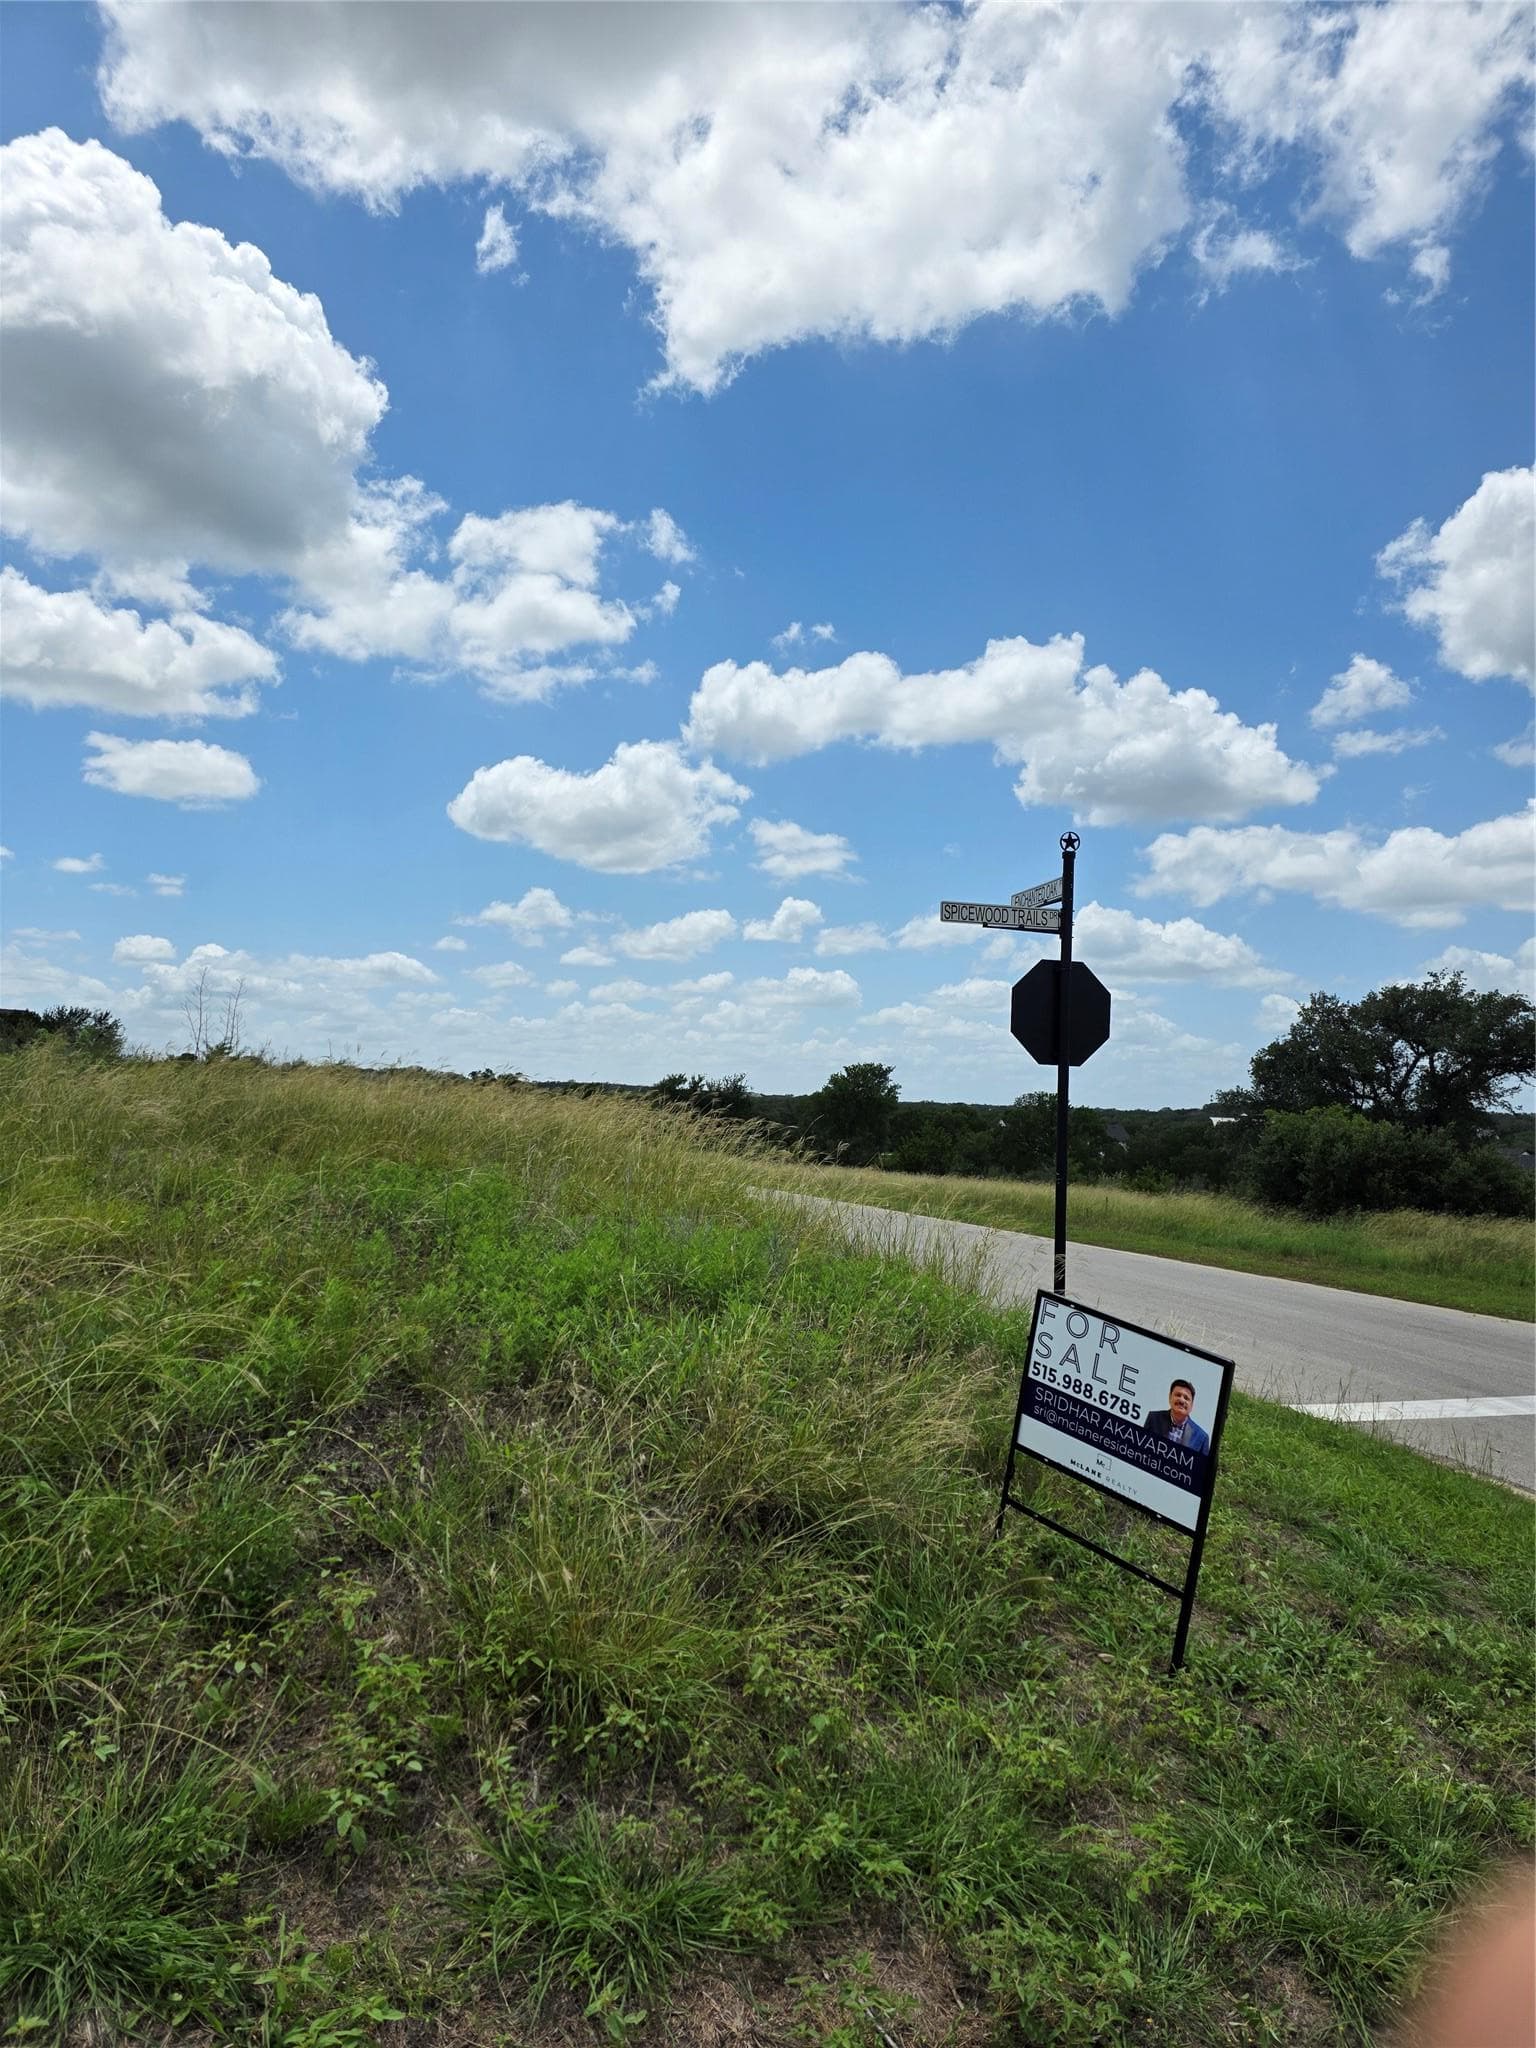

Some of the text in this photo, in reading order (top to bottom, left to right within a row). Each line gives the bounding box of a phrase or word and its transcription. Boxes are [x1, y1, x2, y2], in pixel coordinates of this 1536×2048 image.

[943, 904, 1058, 926] SPICEWOOD TRAILS DR
[1039, 1298, 1122, 1355] FOR
[1031, 1361, 1142, 1421] 515.988.6785
[1035, 1331, 1140, 1397] SALE
[1033, 1403, 1192, 1486] sri@mclaneresidential.com
[1034, 1386, 1195, 1471] SRIDHAR AKAVARAM
[1105, 1476, 1138, 1496] REALTY
